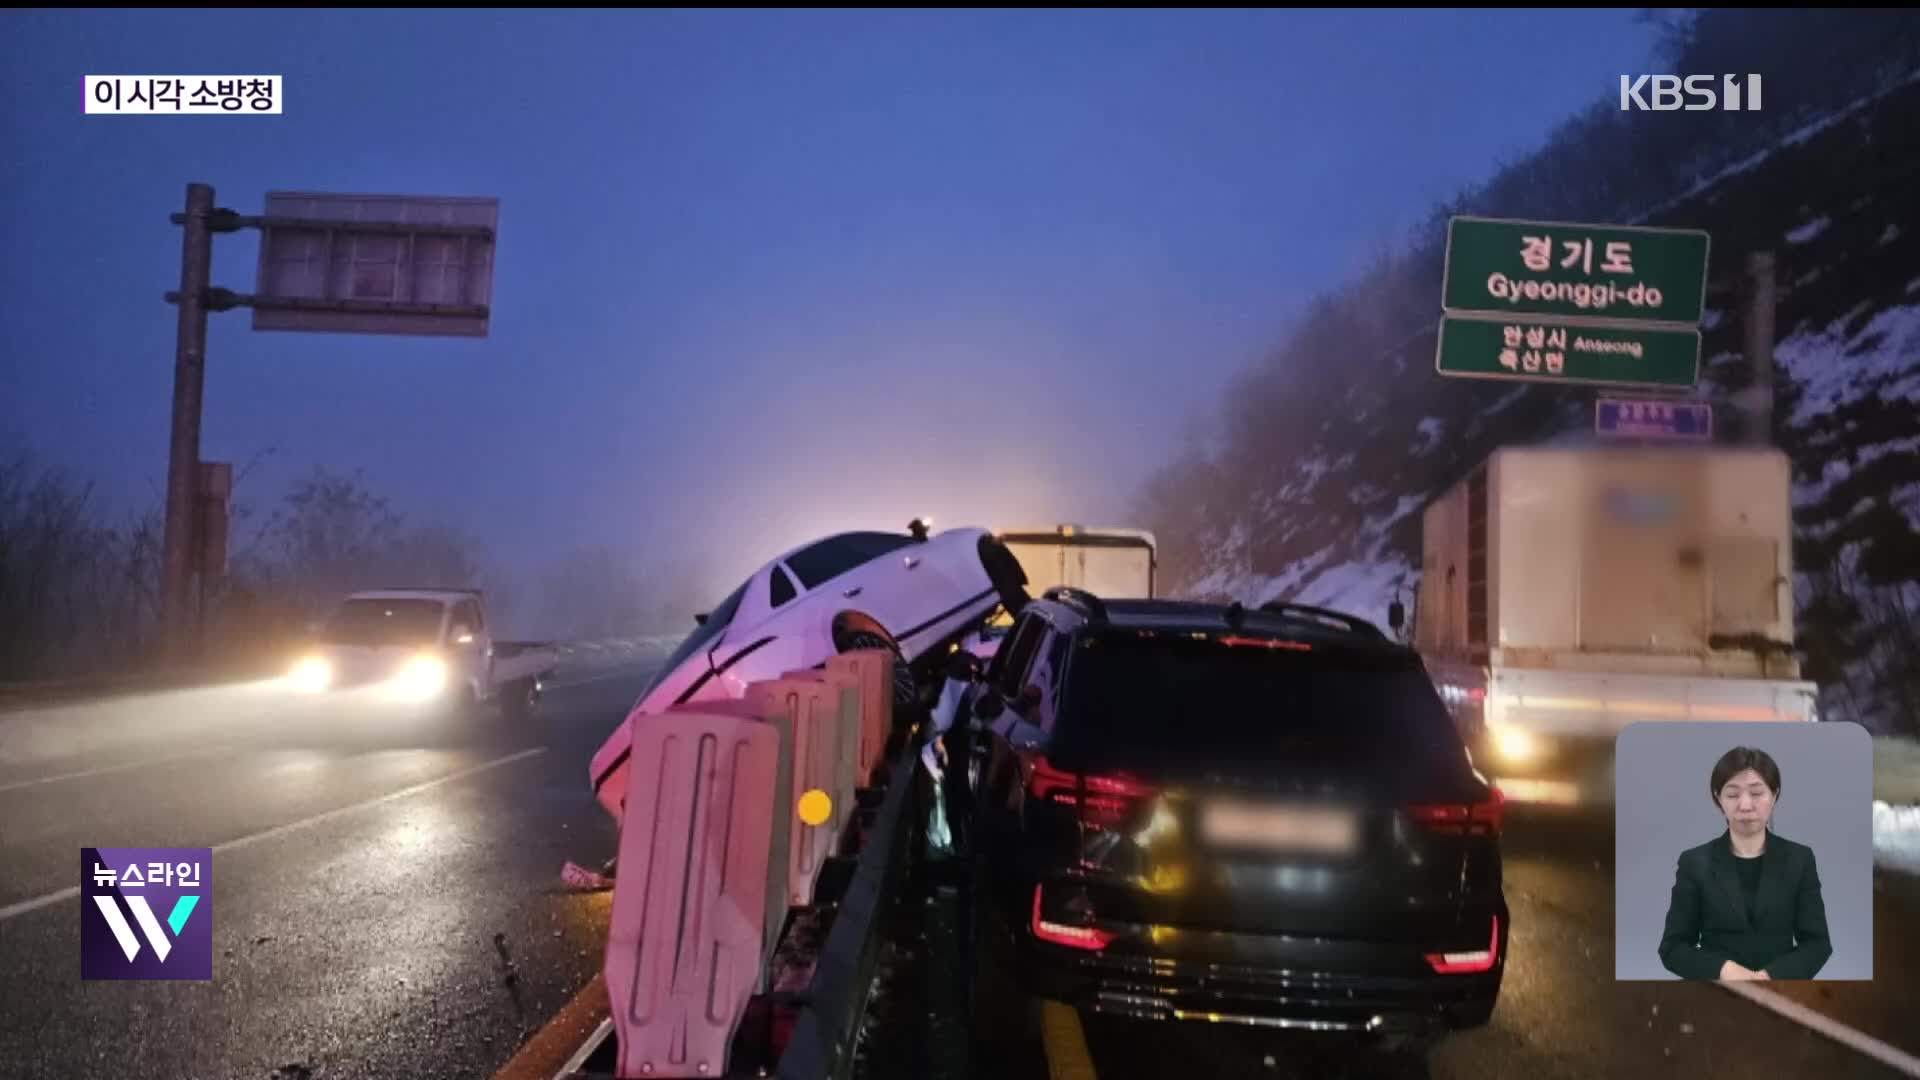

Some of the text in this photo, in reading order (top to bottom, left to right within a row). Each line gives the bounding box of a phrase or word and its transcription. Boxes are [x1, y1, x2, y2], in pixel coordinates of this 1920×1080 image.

[1520, 235, 1634, 275] 경기도
[1487, 273, 1663, 308] Gyeonggi-do
[1574, 335, 1643, 359] Anseong
